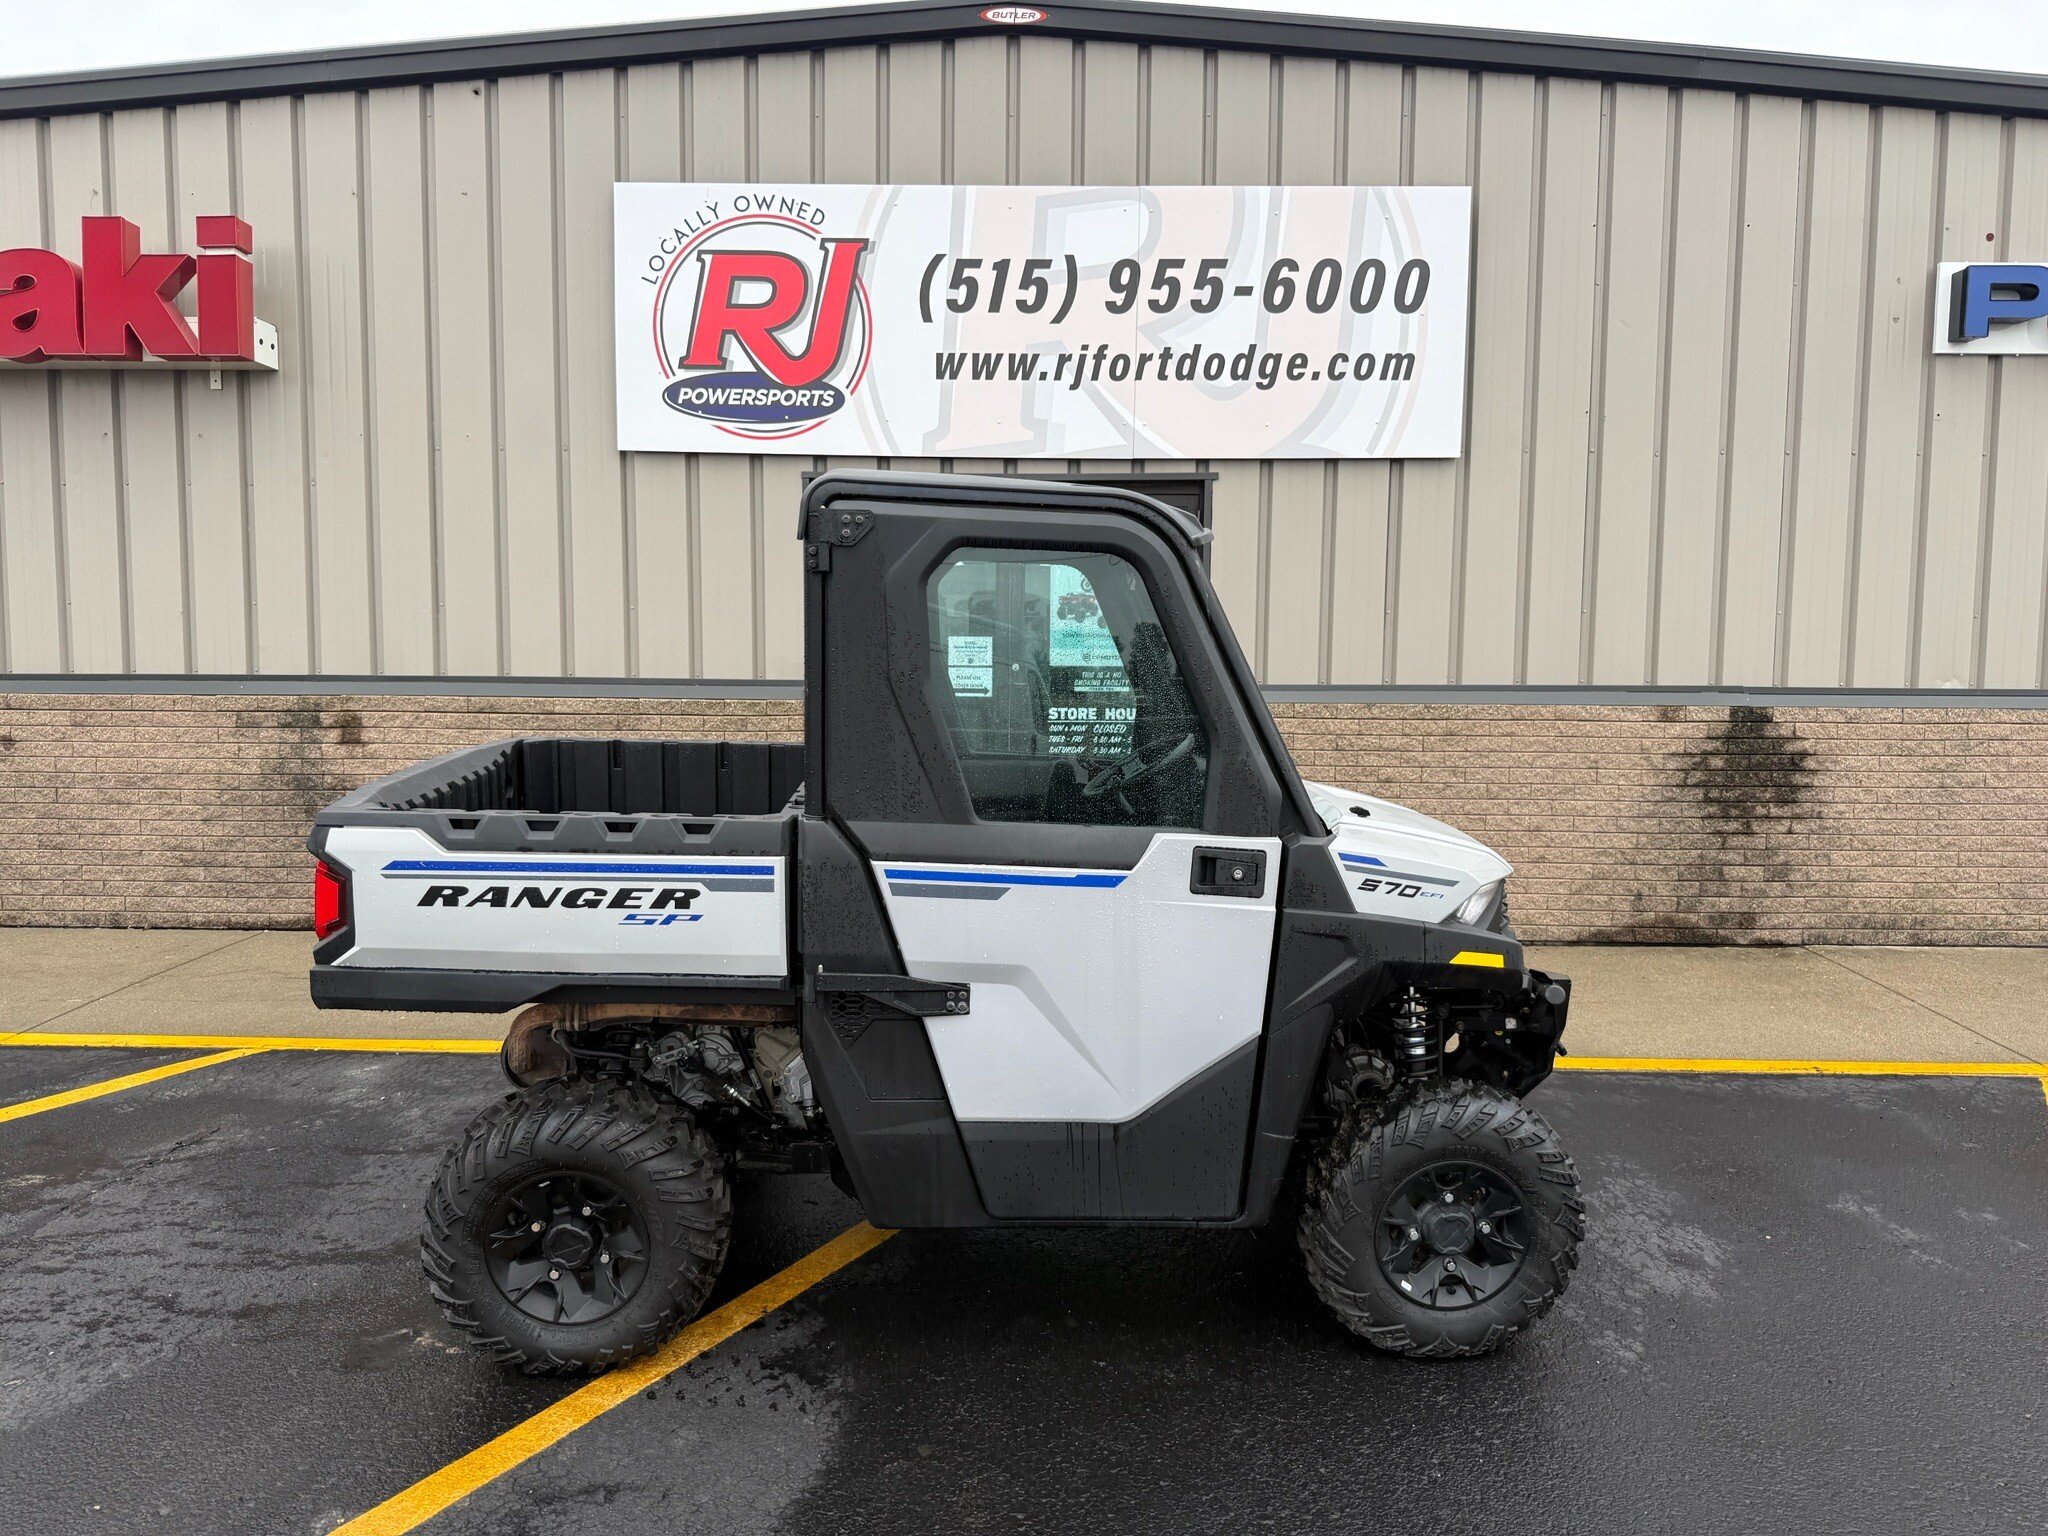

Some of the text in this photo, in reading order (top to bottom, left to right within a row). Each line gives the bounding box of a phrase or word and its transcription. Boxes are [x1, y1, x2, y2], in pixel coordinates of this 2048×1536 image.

[992, 11, 1036, 19] BUTLER
[641, 193, 826, 285] LOCALLY OWNED
[919, 253, 1431, 324] (515) 955-6000
[678, 237, 873, 388] RJ
[935, 343, 1417, 391] www.rjfortdodge.com
[677, 387, 836, 408] POWERSPORTS
[1048, 707, 1098, 720] STORE
[1048, 724, 1064, 732] SUN
[1069, 724, 1088, 732] MON
[1093, 723, 1127, 734] CLOSED
[1048, 735, 1066, 743] TUES
[1071, 735, 1084, 743] FRI
[1048, 745, 1088, 754] SATURDAY
[416, 885, 702, 910] RANGER
[1356, 877, 1444, 899] 570 EFI
[617, 913, 705, 926] SP
